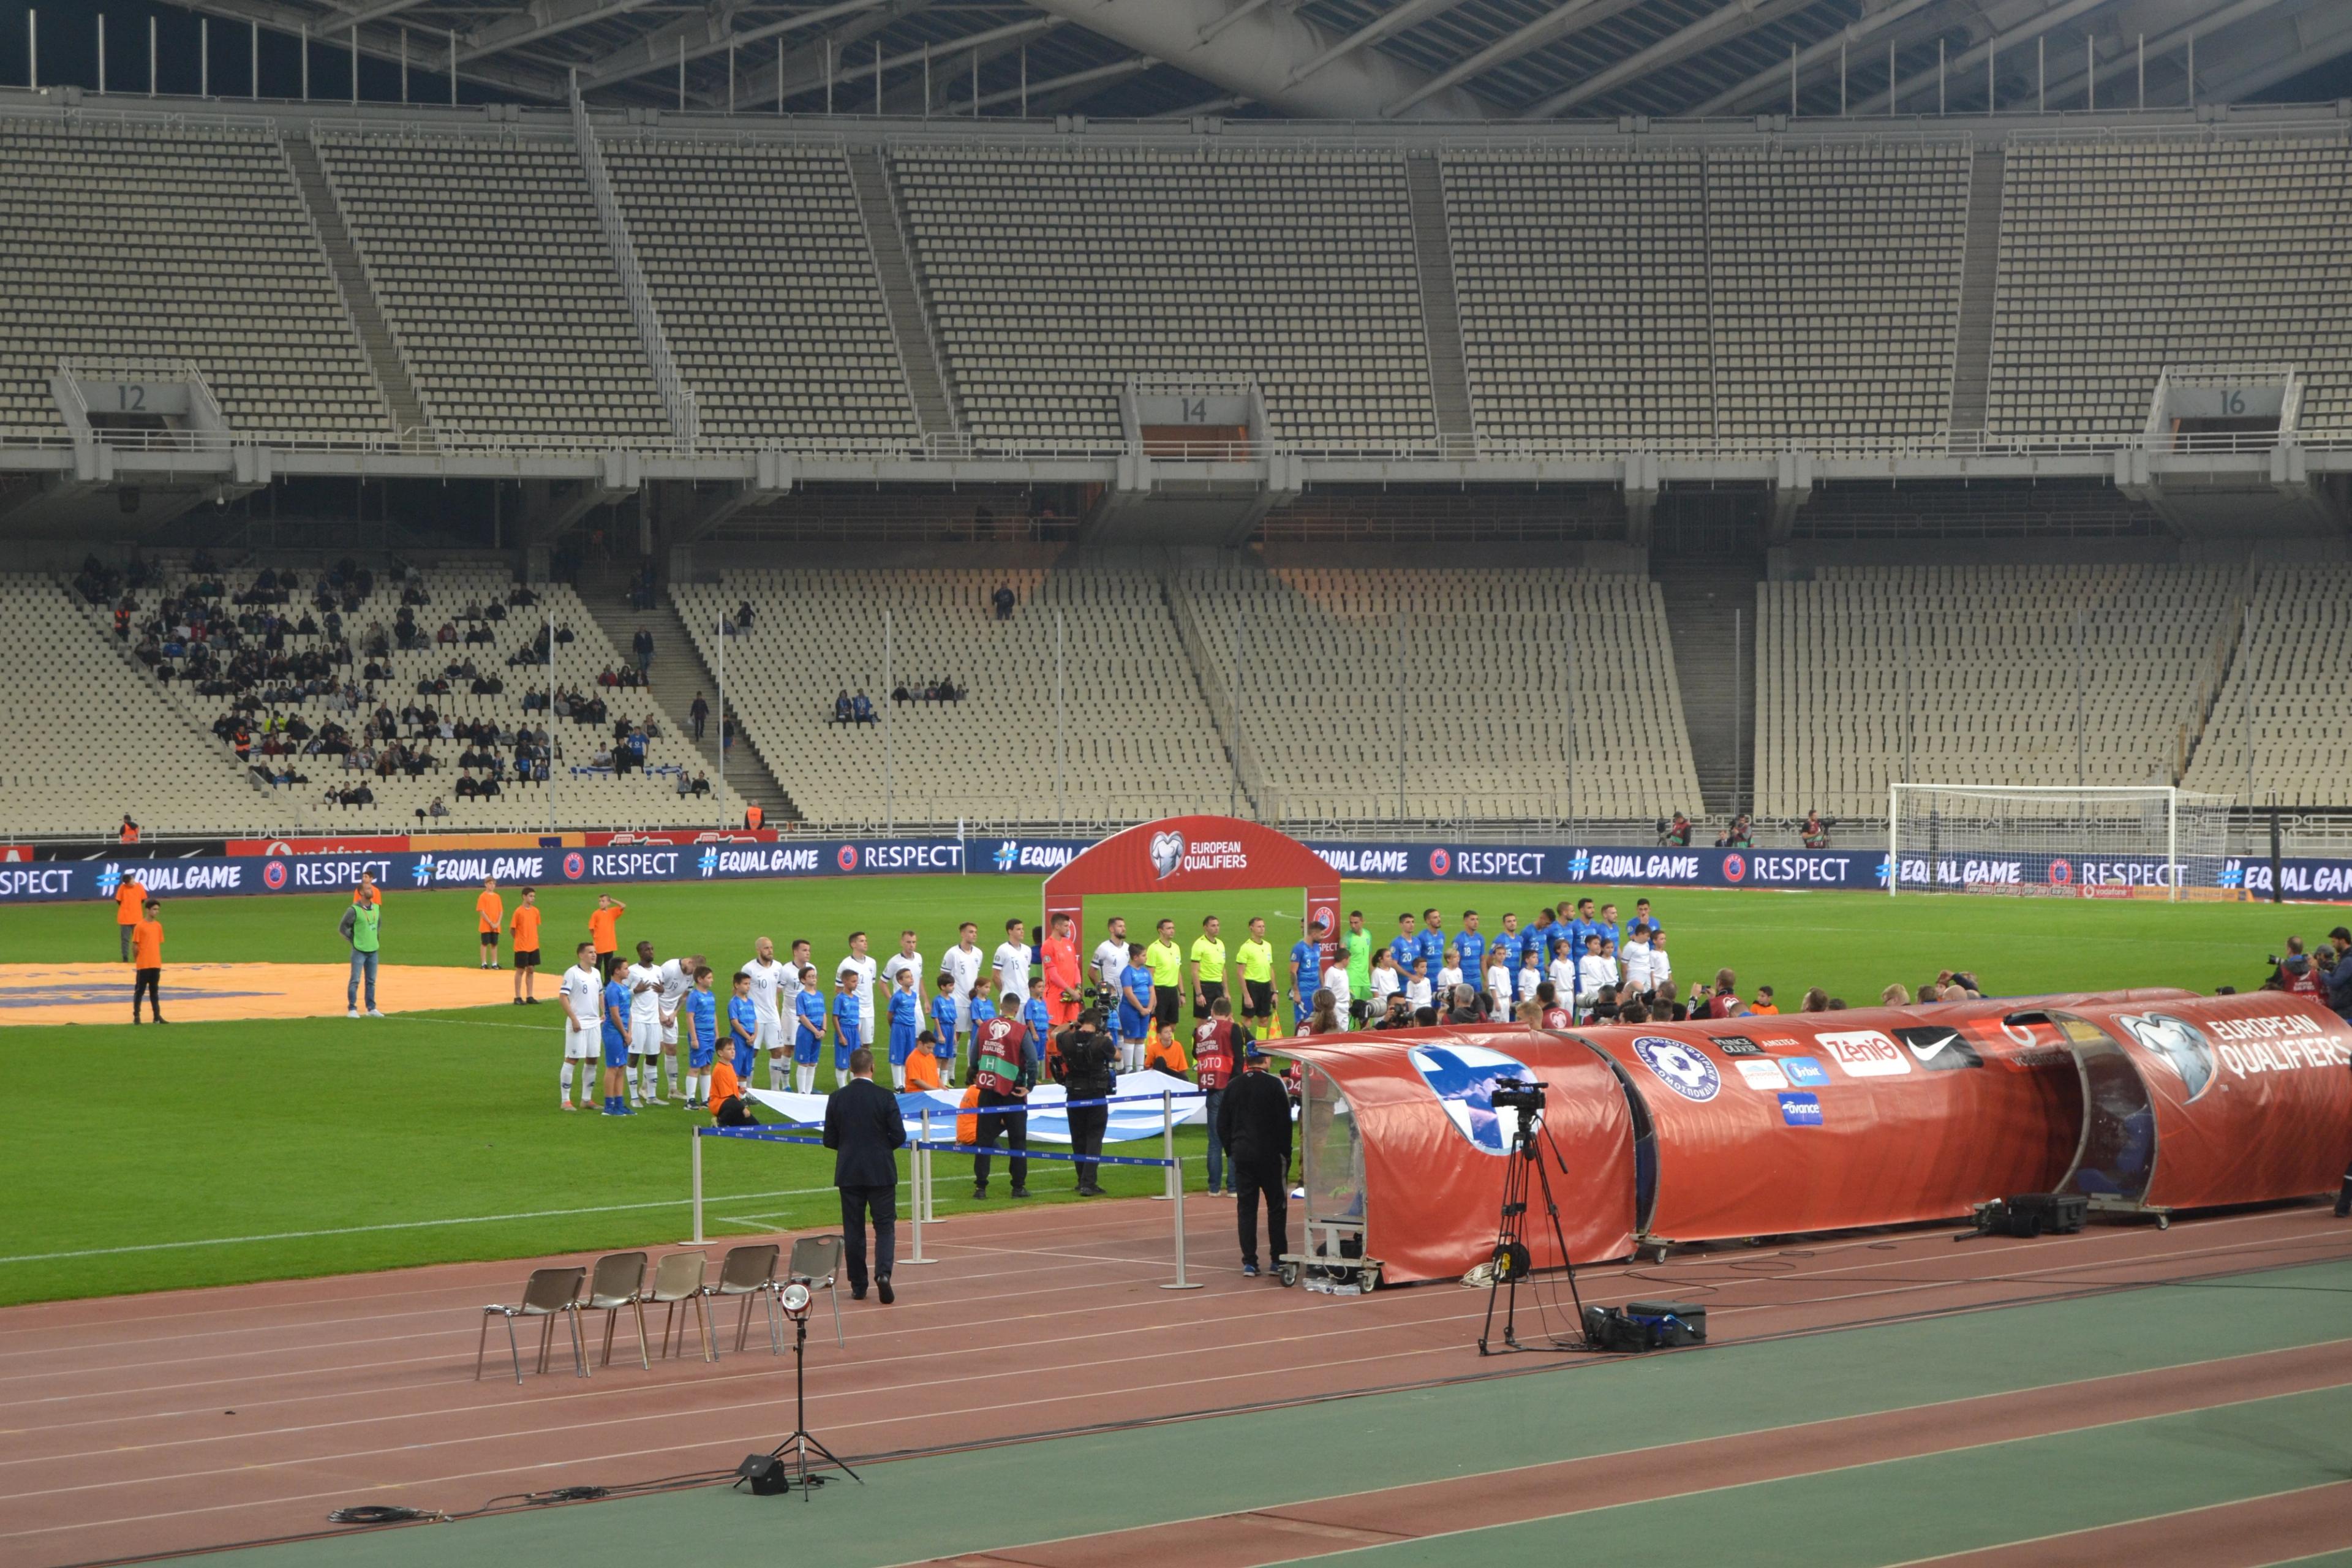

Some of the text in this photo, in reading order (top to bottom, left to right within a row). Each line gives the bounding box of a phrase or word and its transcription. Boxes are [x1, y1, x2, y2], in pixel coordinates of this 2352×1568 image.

[118, 385, 146, 411] 12
[2220, 390, 2245, 415] 16
[1181, 398, 1207, 423] 14
[1190, 841, 1242, 854] EUROPEAN
[865, 845, 962, 868] RESPECT
[993, 840, 1089, 871] #EQUAL
[1183, 854, 1248, 872] QUALIFIERS
[1312, 849, 1408, 872] QUALGAME
[1458, 851, 1545, 875] RESPECT
[592, 852, 679, 875] RESPECT
[1754, 857, 1850, 881] RESPECT
[96, 862, 241, 897] #QUALGAME
[296, 861, 391, 886] RESPECT
[2082, 862, 2188, 887] RESPECT
[1427, 946, 1435, 956] 21
[1463, 946, 1471, 957] 18
[1530, 941, 1539, 951] 22
[1306, 959, 1311, 968] 3
[1402, 952, 1412, 963] 20
[960, 965, 965, 975] 5
[1011, 960, 1019, 971] 15
[582, 984, 588, 994] 8
[668, 981, 679, 991] 19
[757, 979, 767, 989] 10
[2206, 1014, 2323, 1041] EUROPEAN
[1722, 1044, 1761, 1053] OLIVER
[986, 1058, 995, 1069] H
[2010, 1052, 2068, 1067] vodafone
[2218, 1035, 2351, 1080] QUALIFIERS
[979, 1072, 996, 1087] 02
[1200, 1074, 1215, 1086] 45
[1658, 1069, 1716, 1098] ΟΜΟΣΠΟΝΔΙΑ
[1789, 1104, 1820, 1114] avance
